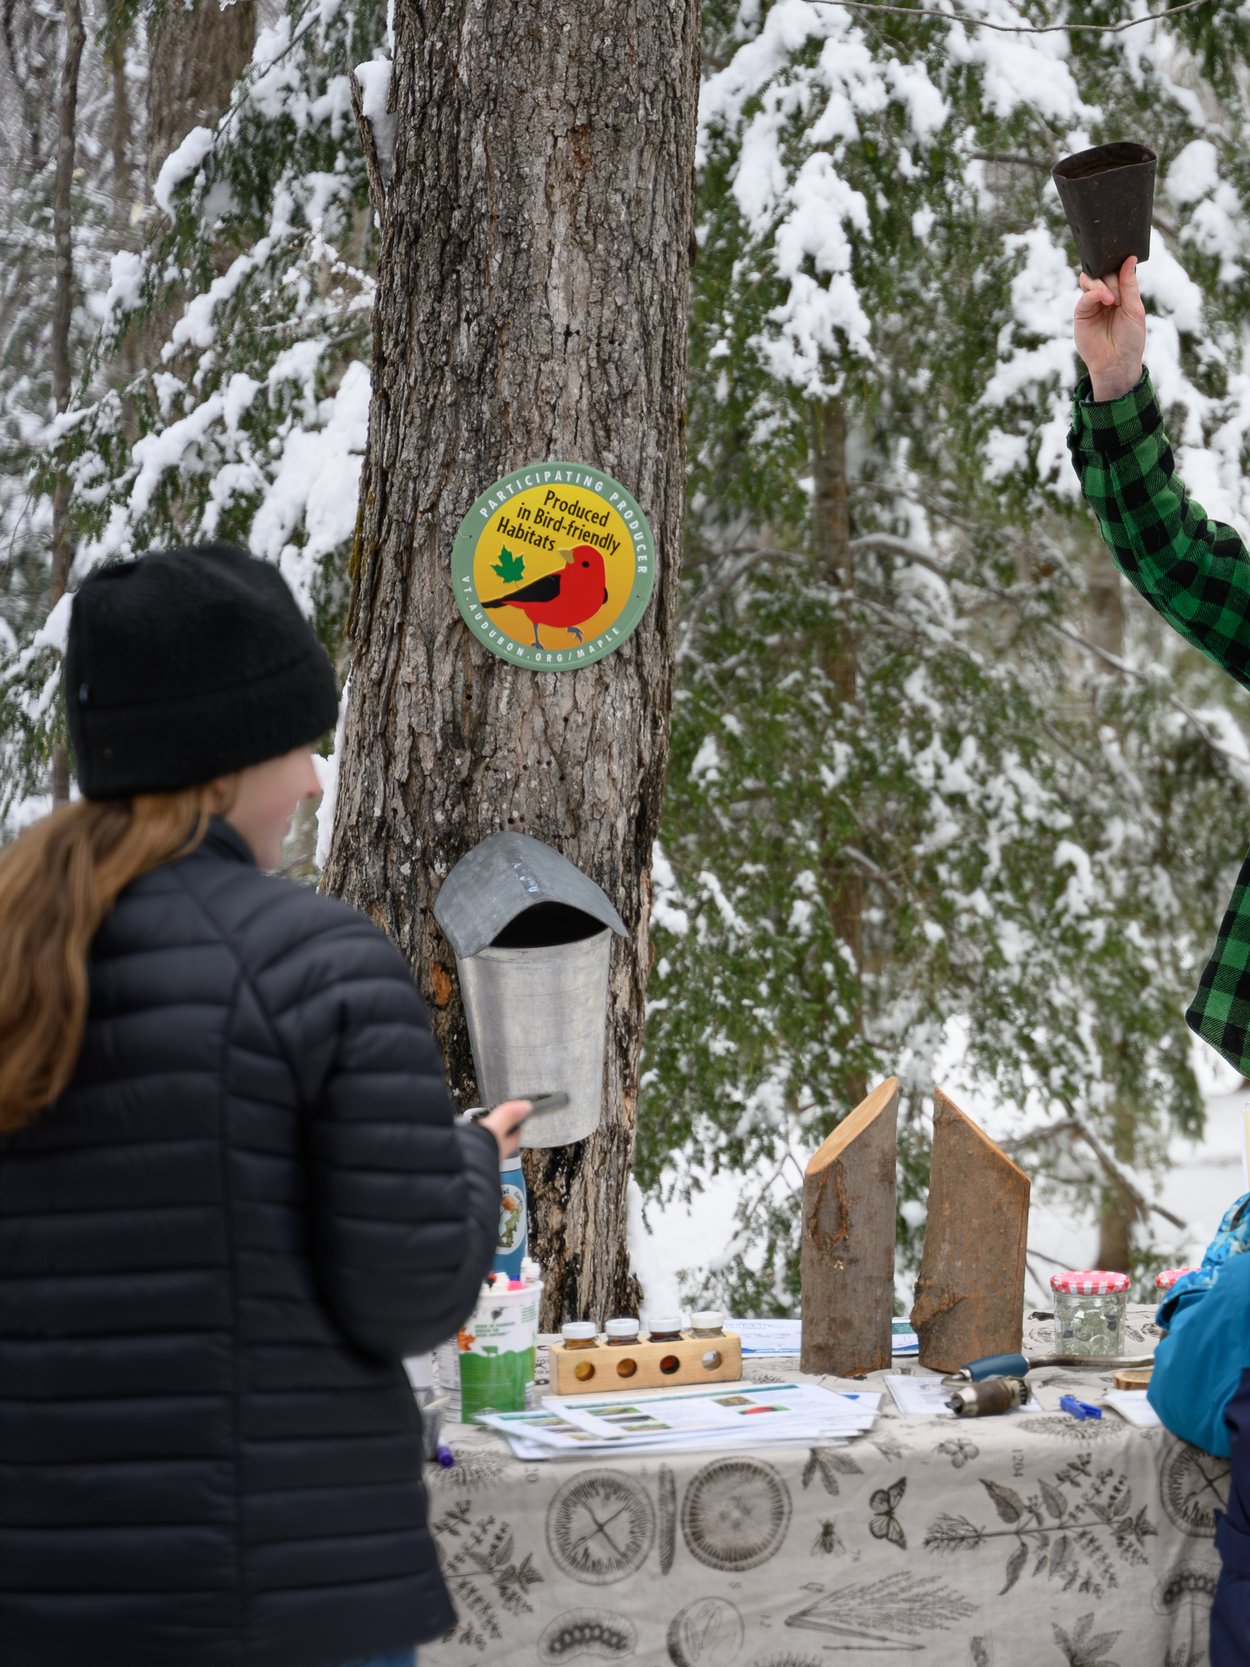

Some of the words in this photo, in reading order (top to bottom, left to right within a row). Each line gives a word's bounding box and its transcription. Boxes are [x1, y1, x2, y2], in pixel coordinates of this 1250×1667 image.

[480, 470, 603, 518] PARTICIPATING
[609, 492, 648, 573] PRODUCER
[496, 516, 556, 552] Habitats
[516, 502, 531, 521] in
[533, 507, 621, 557] Bird-friendly
[543, 489, 610, 528] Produced
[462, 575, 620, 663] VT.AUDUBON.ORG/MAPLE
